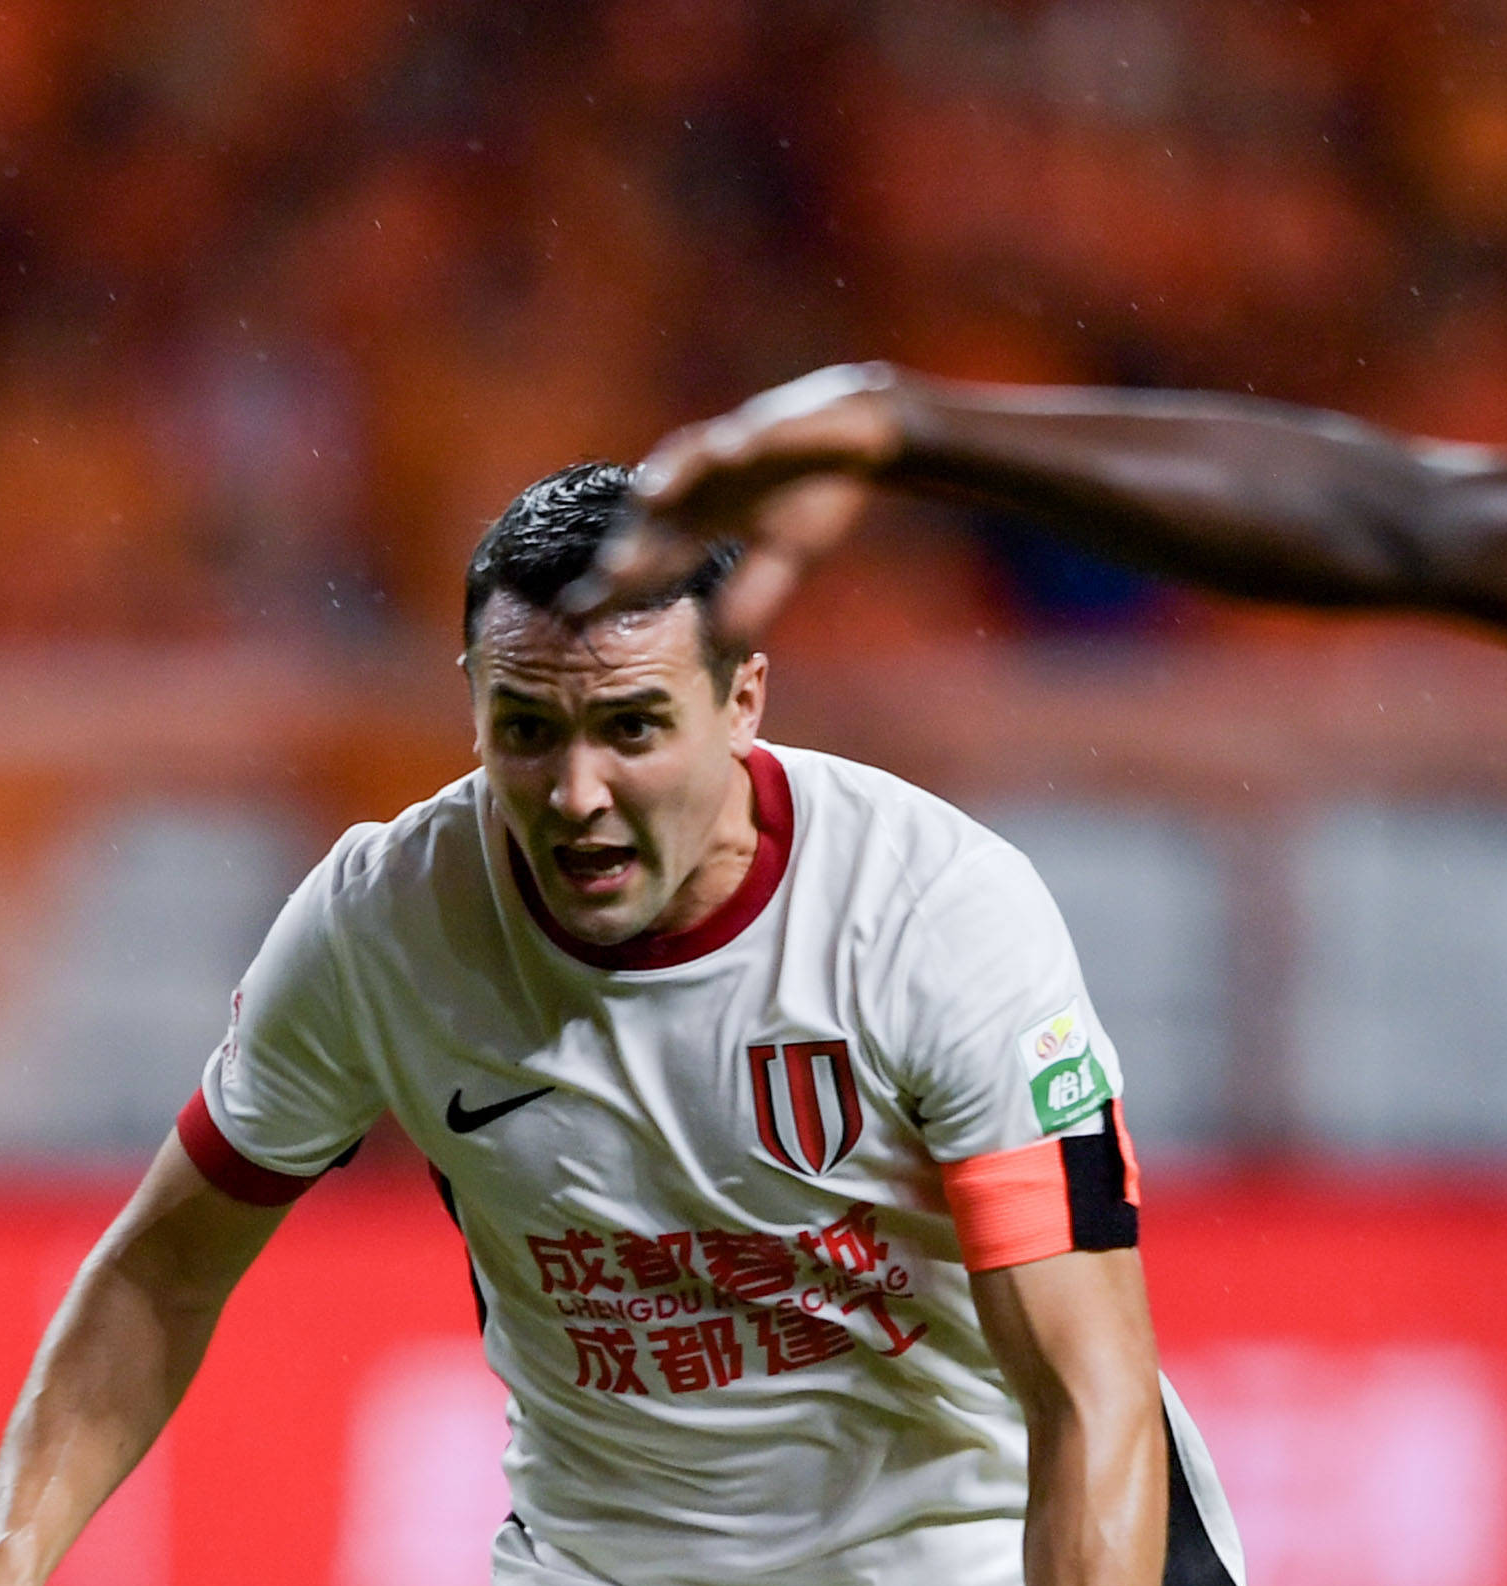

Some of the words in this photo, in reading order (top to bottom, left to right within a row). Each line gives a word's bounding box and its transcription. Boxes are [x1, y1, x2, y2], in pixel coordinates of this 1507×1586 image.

[525, 1200, 889, 1301] 成都蓉城
[564, 1290, 930, 1396] 成都建工
